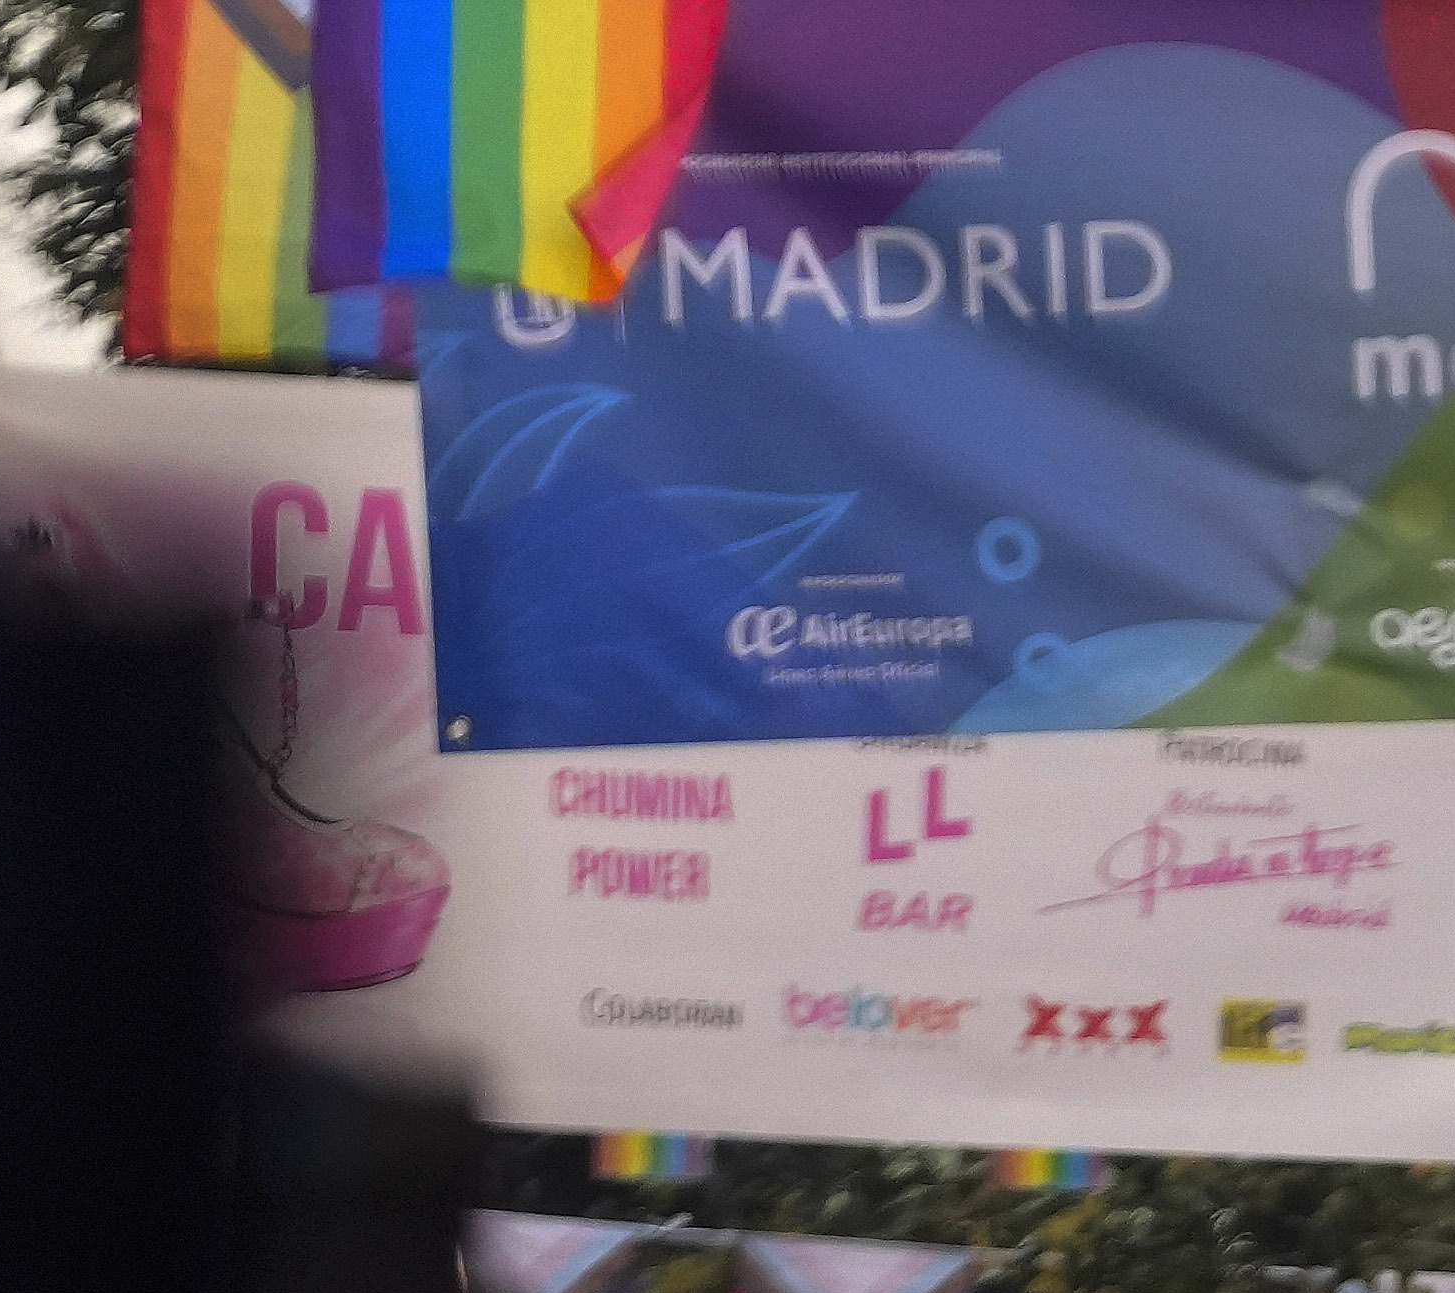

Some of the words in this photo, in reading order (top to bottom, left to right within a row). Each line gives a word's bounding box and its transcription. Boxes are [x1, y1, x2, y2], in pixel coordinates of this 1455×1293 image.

[660, 221, 1172, 325] MADRID
[551, 766, 734, 822] CHUMINA
[572, 847, 710, 901] POWER
[858, 891, 974, 931] BAR
[784, 981, 973, 1033] belover
